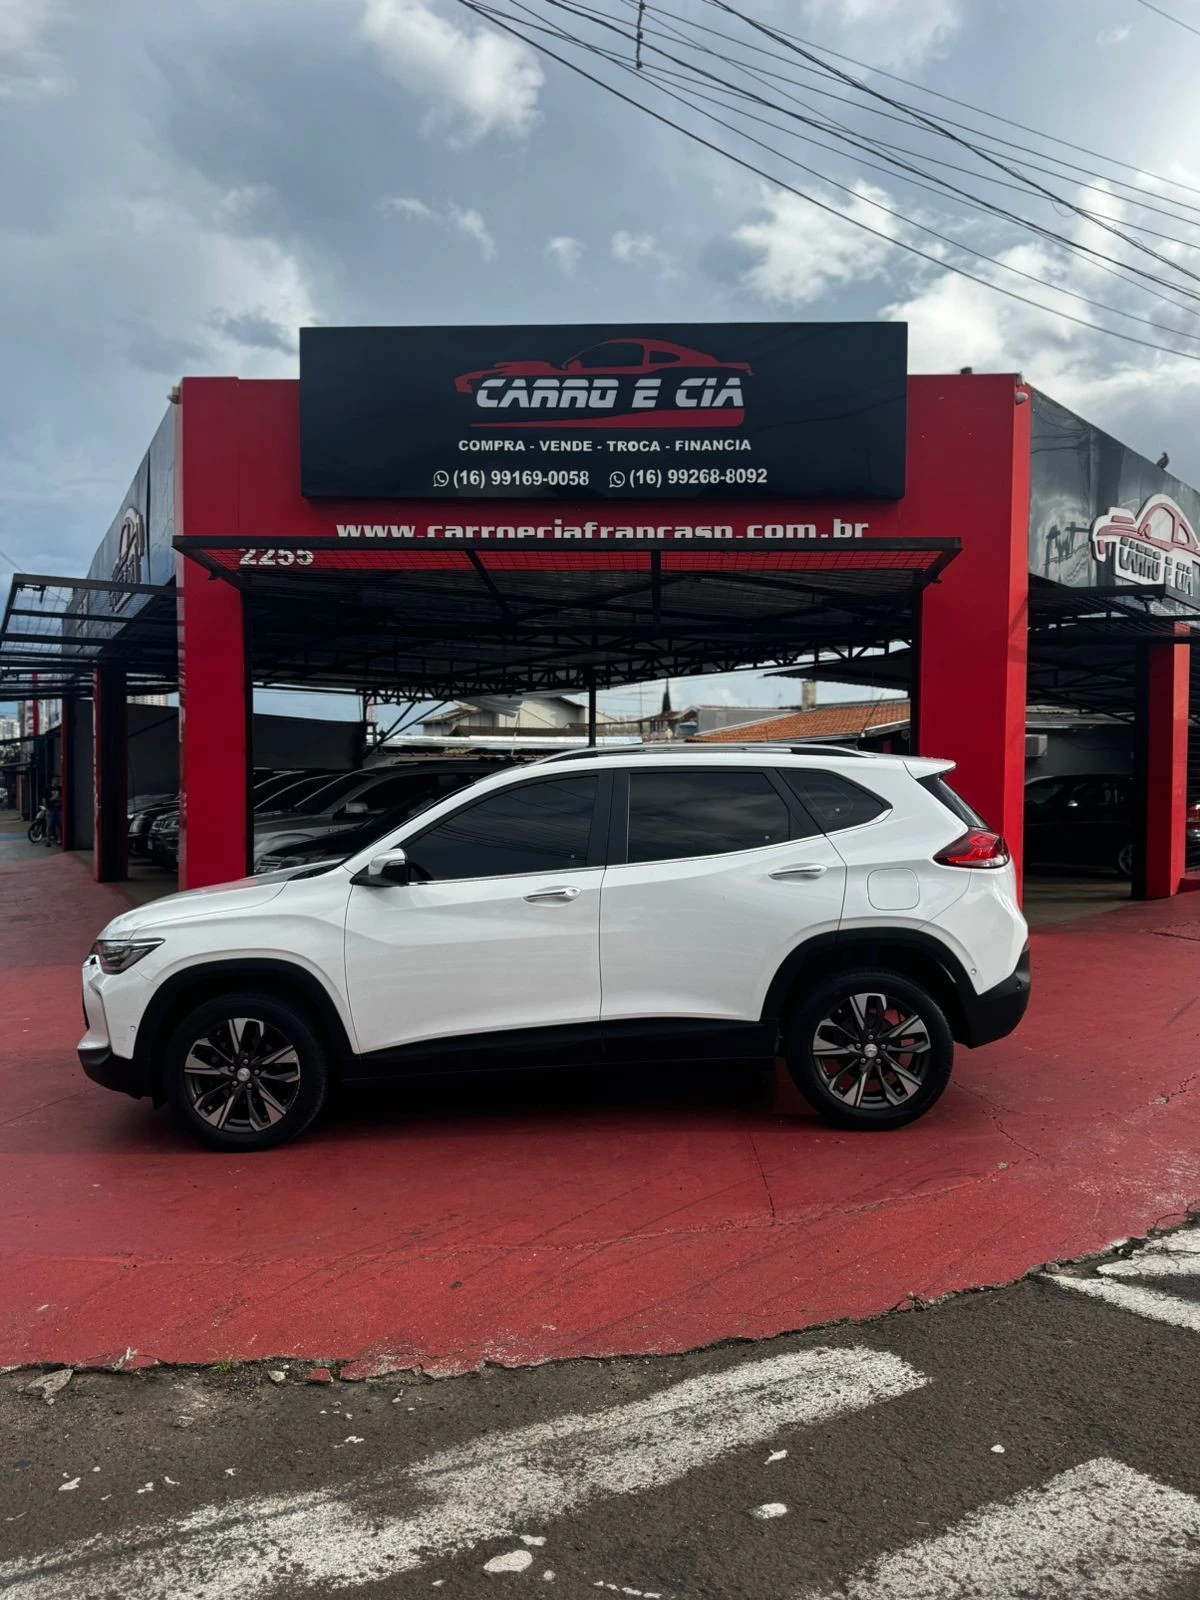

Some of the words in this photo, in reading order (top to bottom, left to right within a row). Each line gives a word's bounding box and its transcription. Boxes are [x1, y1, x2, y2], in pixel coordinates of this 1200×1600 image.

[476, 378, 620, 408] CARRO
[631, 378, 662, 408] E
[675, 377, 745, 407] CIA
[458, 440, 526, 451] COMPRA
[539, 440, 593, 452] VENDE
[606, 440, 661, 452] TROCA
[675, 439, 752, 451] FINANCIA
[453, 470, 486, 488] (16)
[491, 470, 590, 486] 99169-0058
[629, 469, 662, 488] (16)
[667, 468, 768, 484] 99268-8092
[239, 549, 314, 566] 2255
